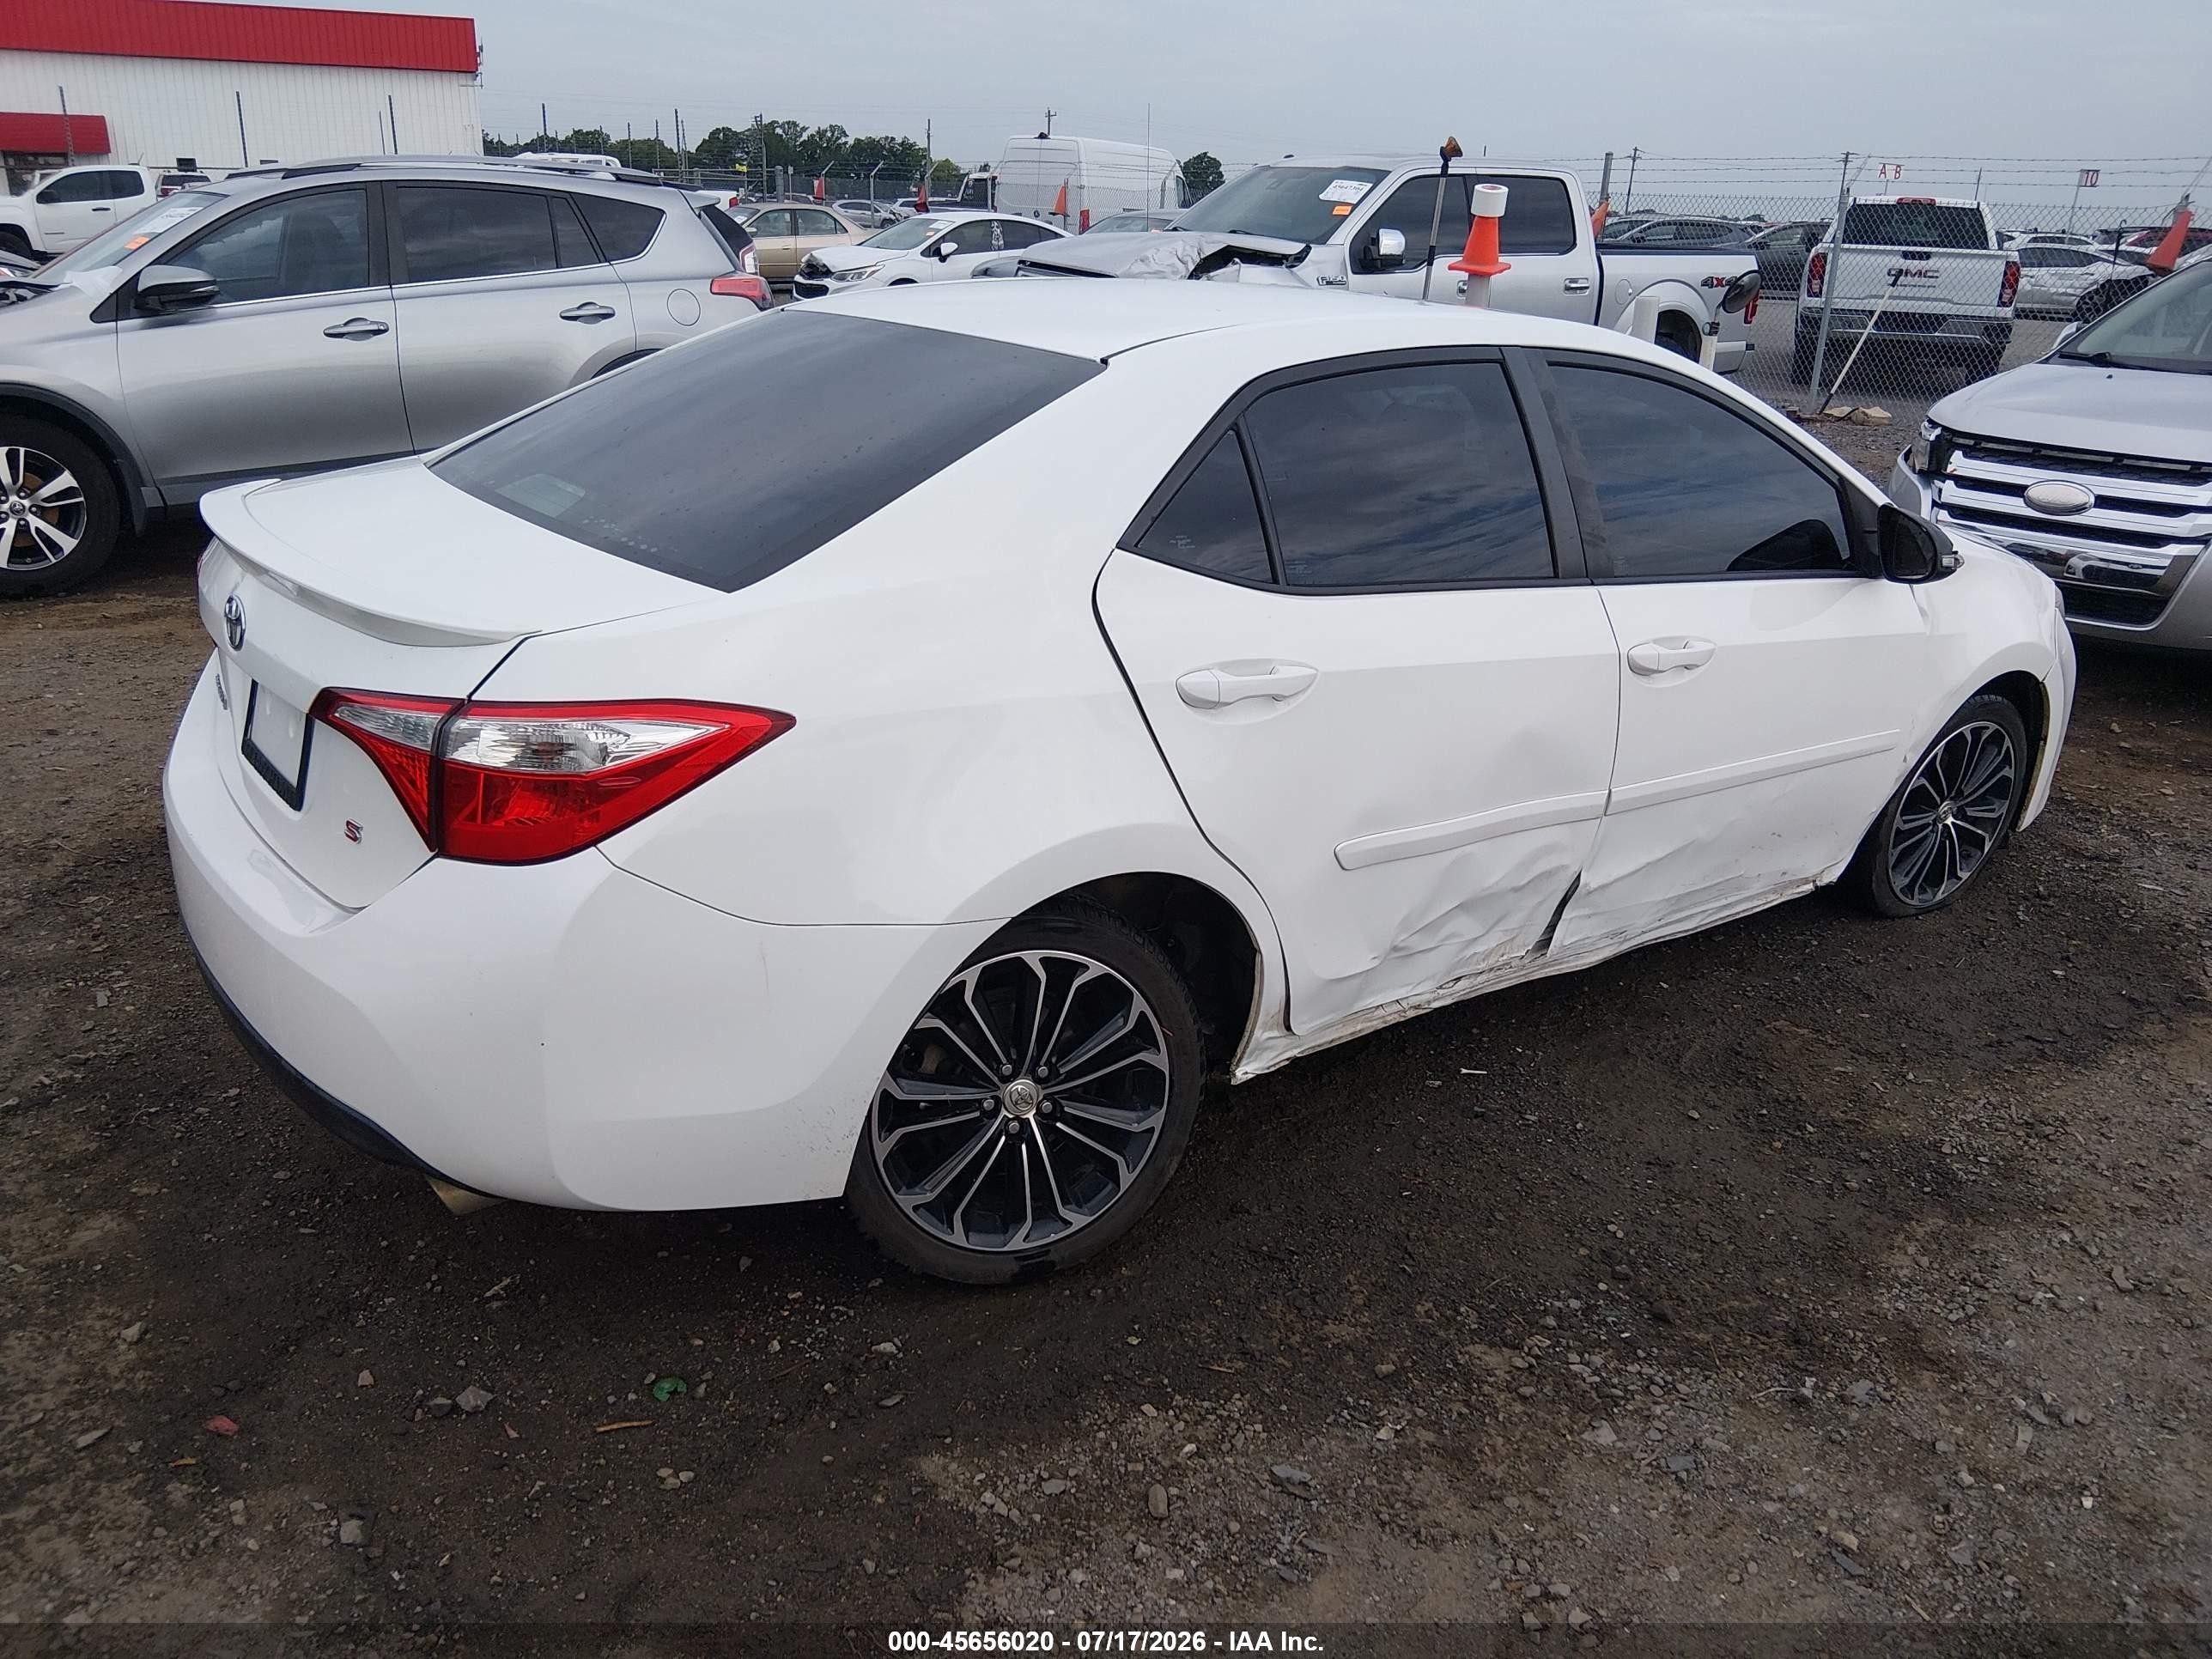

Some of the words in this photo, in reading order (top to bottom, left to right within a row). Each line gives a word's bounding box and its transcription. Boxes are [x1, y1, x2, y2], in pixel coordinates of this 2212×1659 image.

[1878, 163, 1887, 179] A
[1894, 164, 1902, 179] B
[2084, 171, 2100, 186] 10
[344, 818, 363, 844] S
